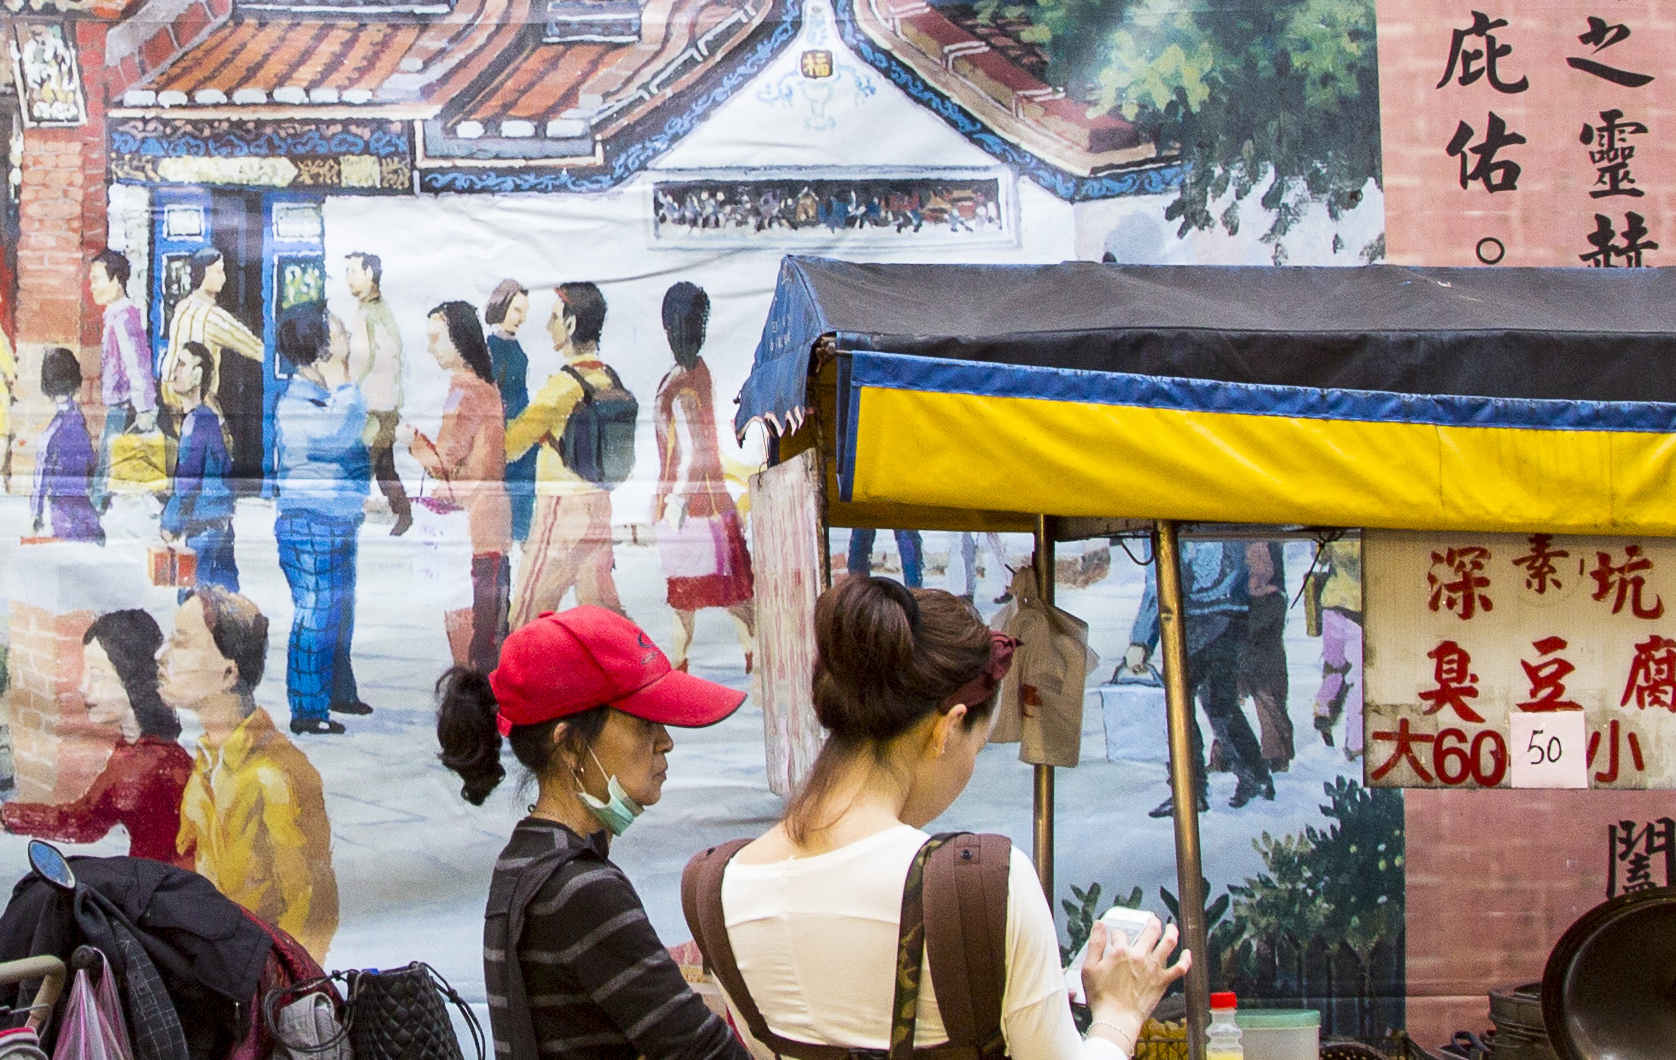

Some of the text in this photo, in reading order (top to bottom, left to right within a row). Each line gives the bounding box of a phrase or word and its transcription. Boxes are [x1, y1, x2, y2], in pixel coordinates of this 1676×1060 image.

[1417, 634, 1676, 723] 臭豆腐
[1526, 729, 1563, 766] 50
